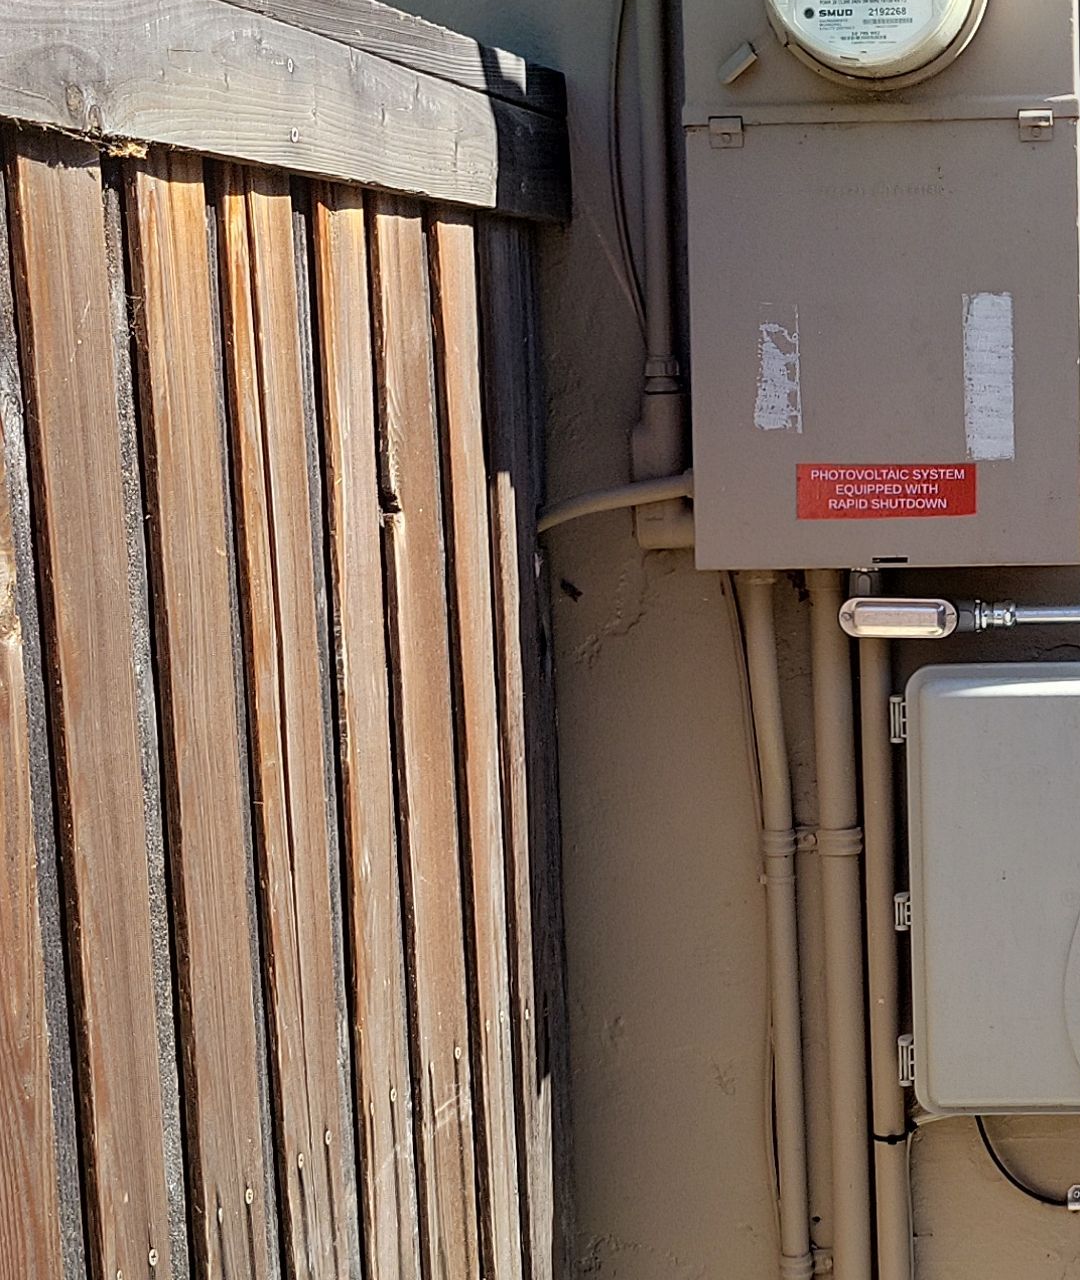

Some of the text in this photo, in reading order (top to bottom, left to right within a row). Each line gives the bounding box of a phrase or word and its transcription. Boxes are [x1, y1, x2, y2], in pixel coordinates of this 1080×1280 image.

[818, 7, 907, 17] SMUD 2192268
[811, 469, 965, 480] PHOTOVOLTAIC SYSTEM
[836, 484, 938, 497] EQUIPPED WITH
[828, 498, 947, 509] RAPID SHUTDOWN
